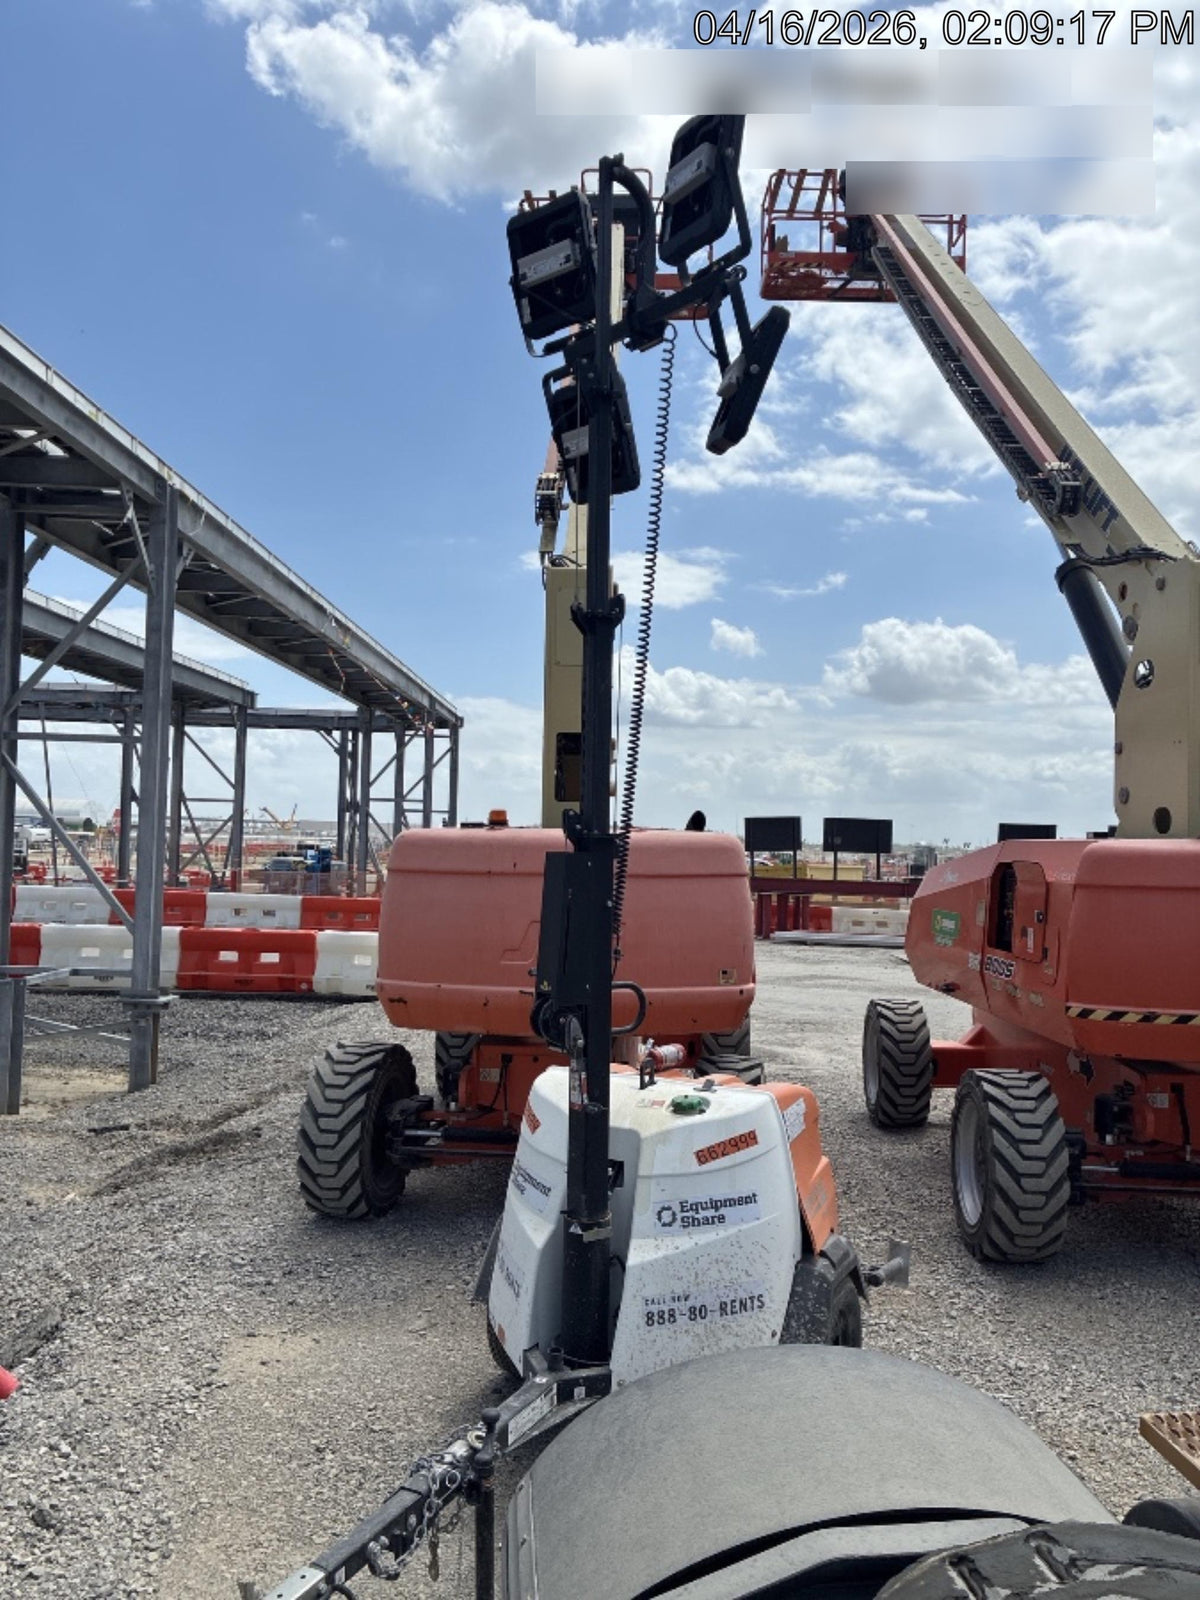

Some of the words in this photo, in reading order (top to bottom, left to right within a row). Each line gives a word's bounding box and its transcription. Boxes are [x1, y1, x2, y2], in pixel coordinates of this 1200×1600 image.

[696, 1130, 757, 1165] 662999
[678, 1192, 758, 1214] Equipment
[679, 1213, 727, 1229] Share
[645, 1294, 766, 1327] 888-80-RENTS
